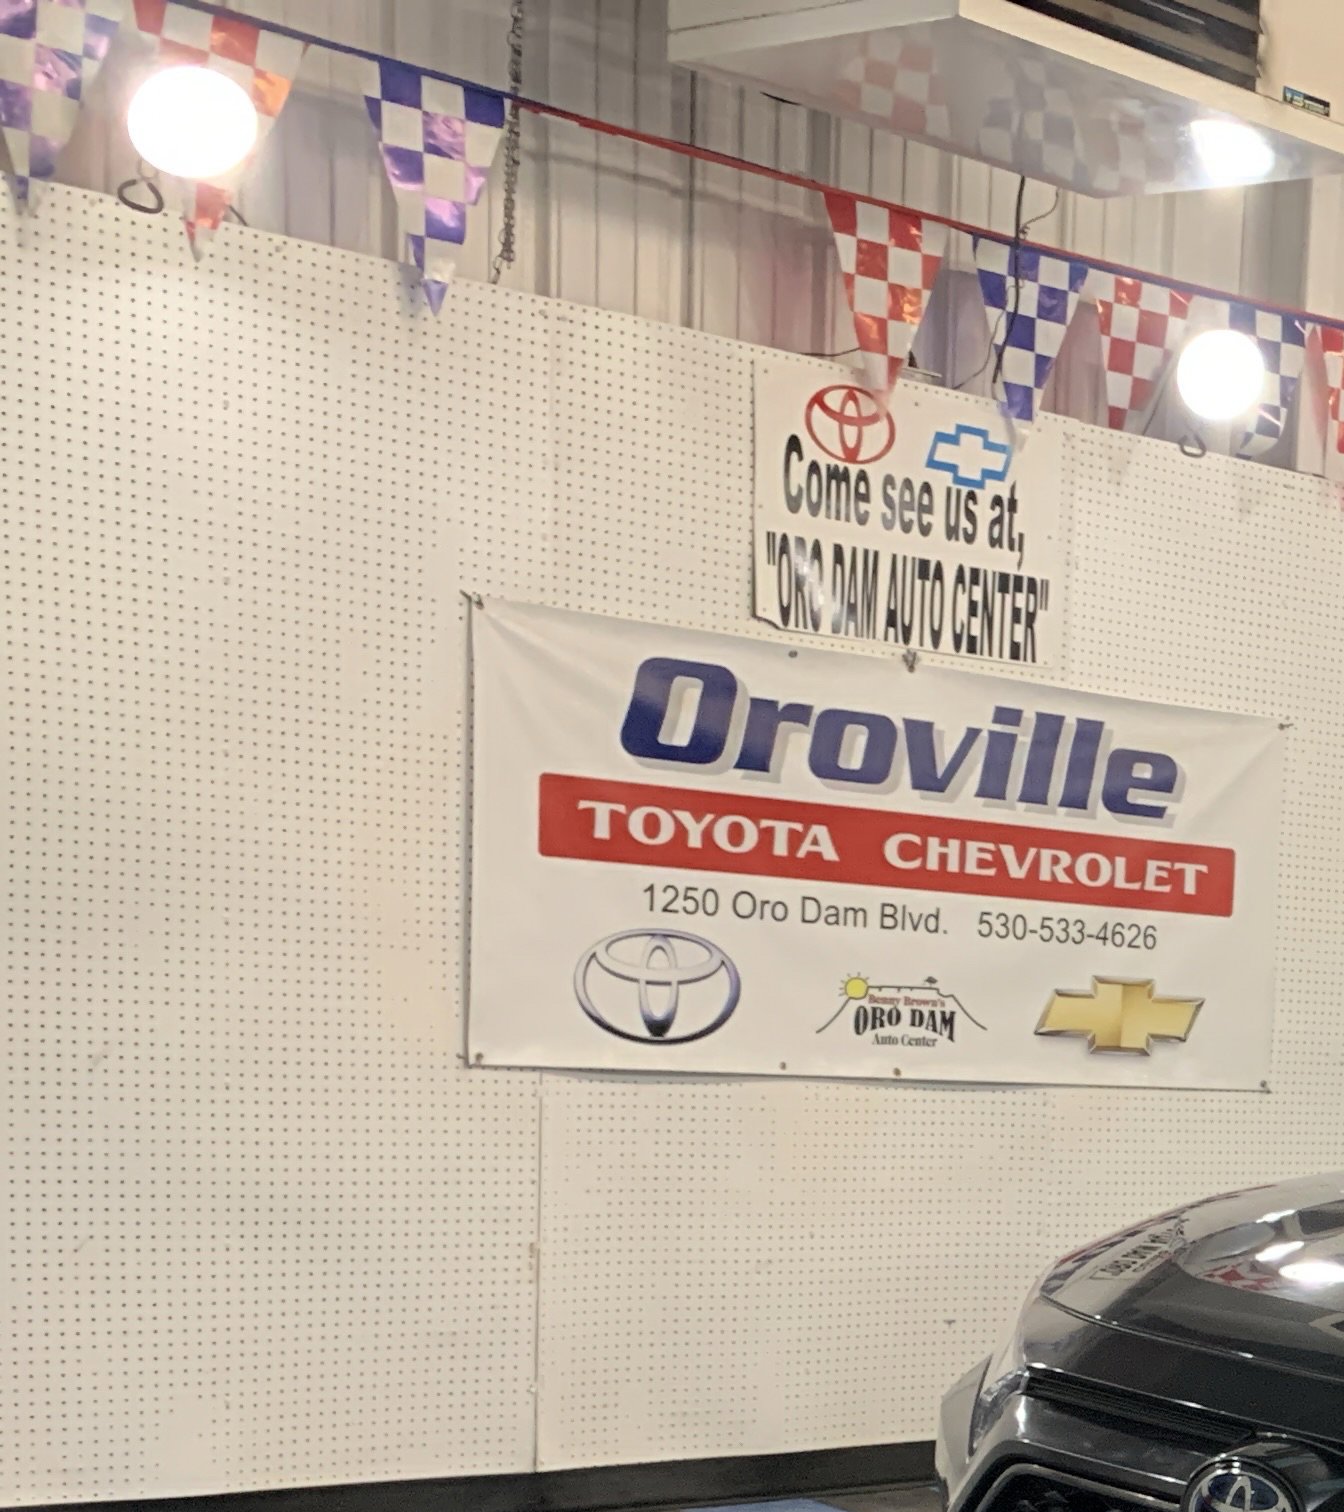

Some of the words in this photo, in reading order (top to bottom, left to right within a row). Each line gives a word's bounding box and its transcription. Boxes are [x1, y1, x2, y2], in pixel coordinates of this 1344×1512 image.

[783, 434, 871, 526] Come
[882, 474, 934, 537] see
[945, 486, 978, 544] us
[988, 481, 1025, 568] at,
[831, 543, 880, 640] DAM
[884, 553, 944, 650] AUTO
[620, 656, 1182, 821] Oroville
[577, 799, 840, 862] TOYOTA
[883, 832, 1209, 896] CHEVROLET
[643, 882, 720, 917] 1250
[732, 890, 789, 922] Oro
[801, 896, 868, 928] Dam
[879, 902, 948, 935] Blvd.
[977, 912, 1157, 951] 530-533-4626
[854, 1005, 902, 1036] ORO
[909, 1008, 957, 1042] DAM
[872, 1033, 899, 1046] Auto
[901, 1034, 938, 1047] Center
